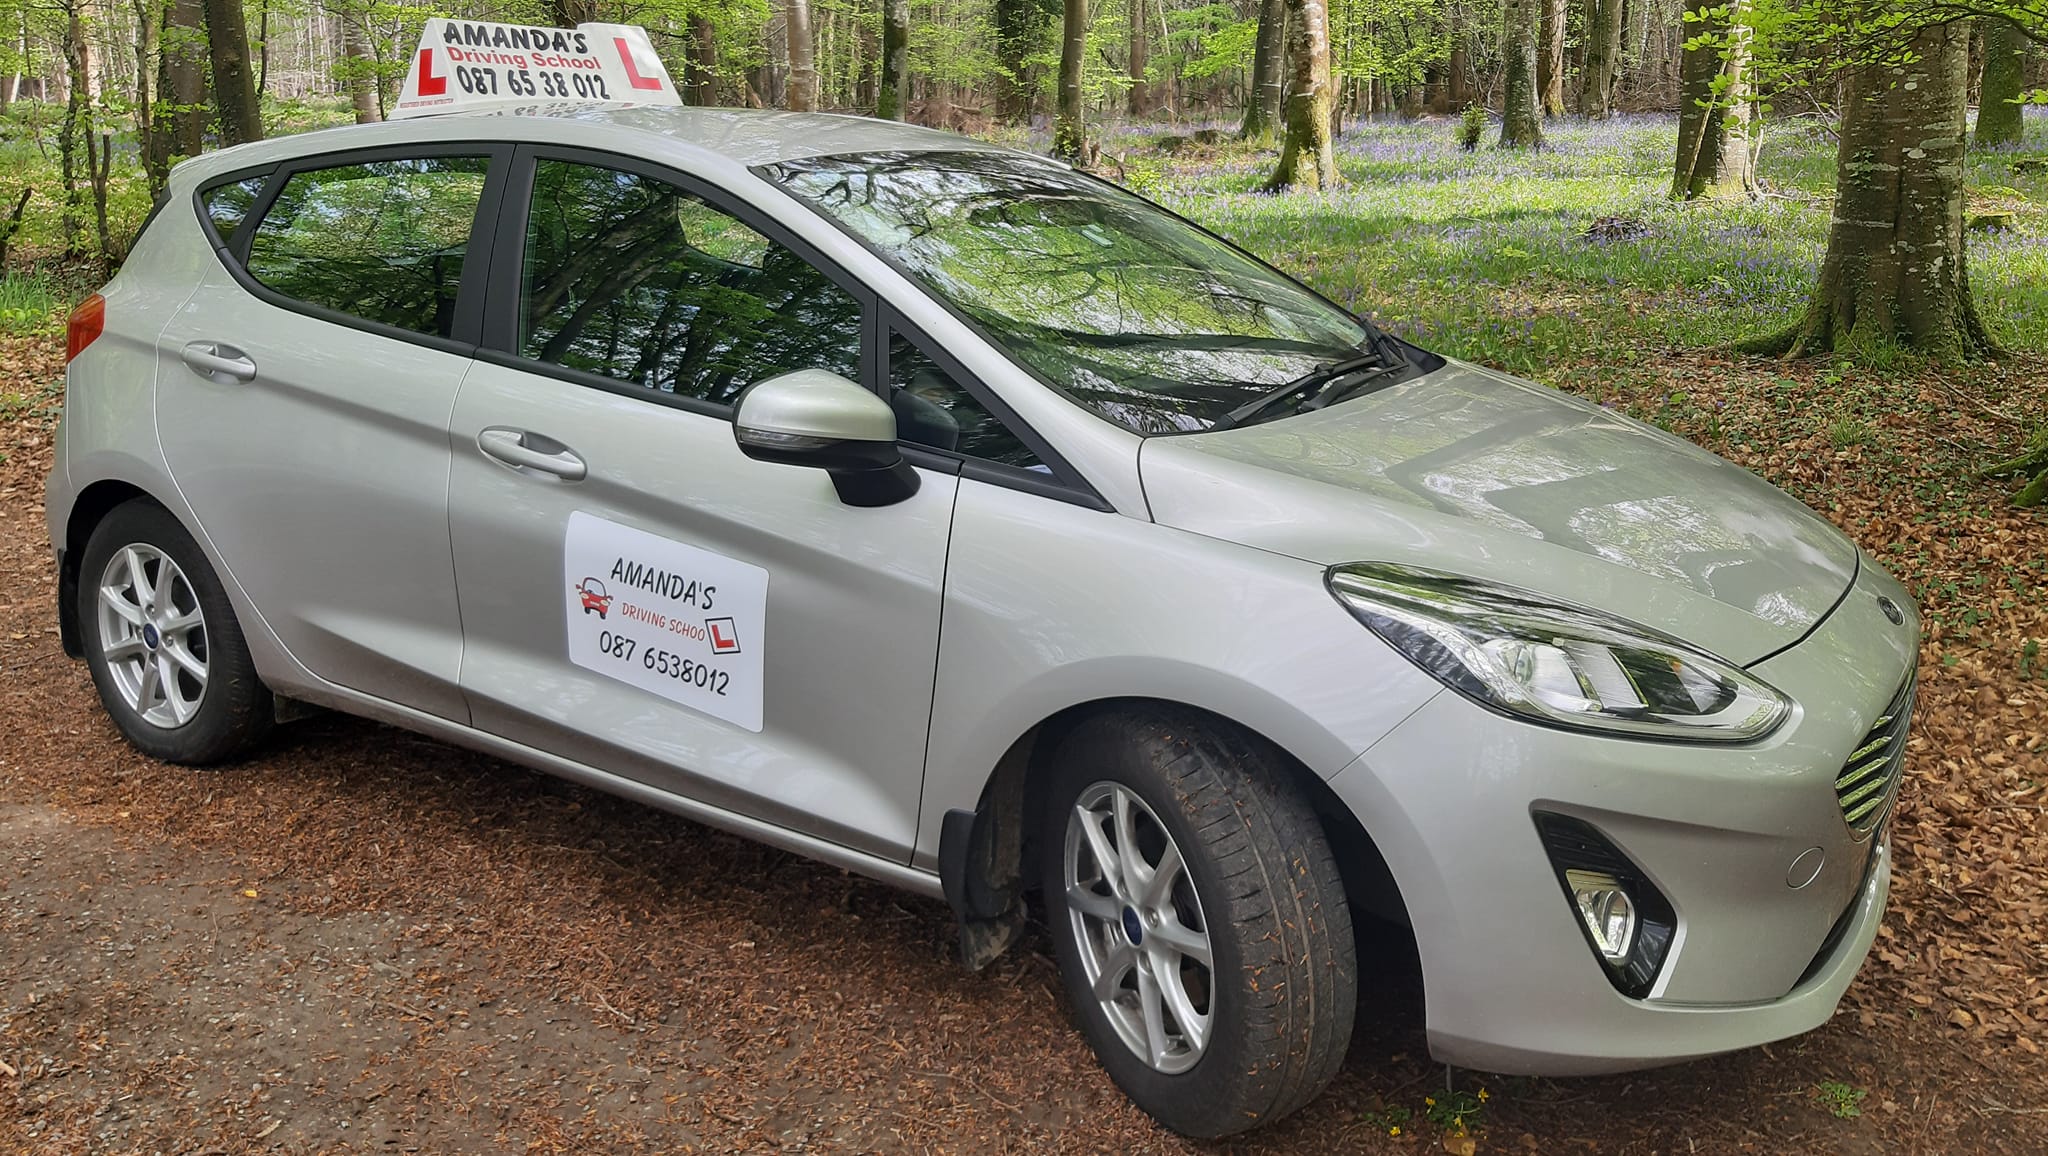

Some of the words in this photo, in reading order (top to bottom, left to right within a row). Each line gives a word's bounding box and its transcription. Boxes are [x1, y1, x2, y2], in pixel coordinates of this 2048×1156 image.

[443, 22, 589, 54] AMANDA'S
[446, 46, 528, 69] Driving
[532, 51, 602, 70] School
[418, 48, 447, 96] L
[456, 65, 498, 95] 087
[507, 69, 536, 97] 65
[540, 71, 569, 98] 38
[572, 73, 611, 100] 012
[613, 37, 663, 91] L
[611, 557, 717, 610] AMANDA'S
[622, 602, 666, 628] DRIVING
[600, 630, 636, 662] 087
[643, 647, 730, 696] 6538012
